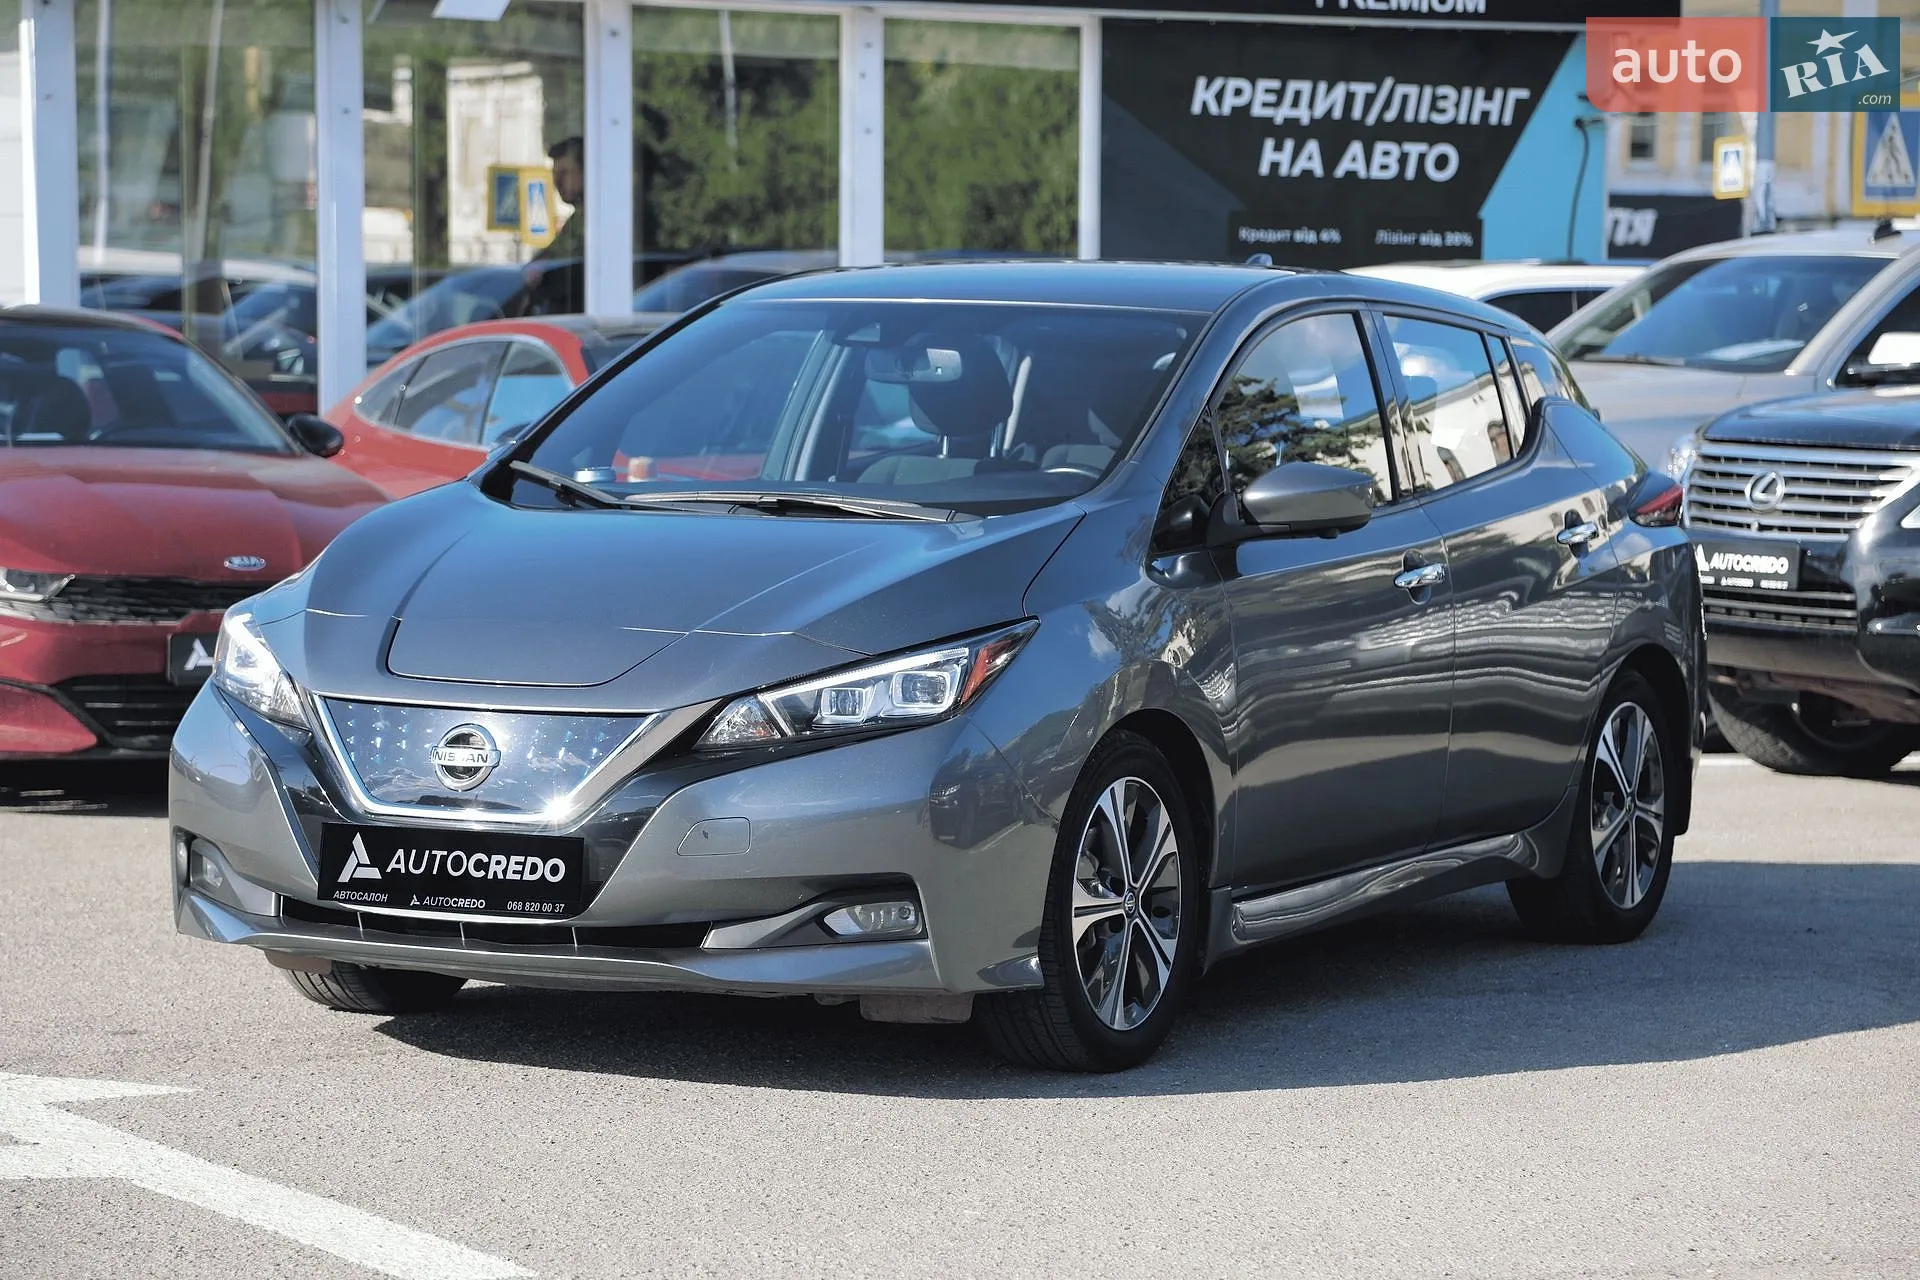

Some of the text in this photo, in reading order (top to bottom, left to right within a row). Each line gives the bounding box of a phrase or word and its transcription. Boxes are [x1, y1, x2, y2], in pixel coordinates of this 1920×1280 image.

[1190, 76, 1530, 127] КРЕДИТ/ЛІЗІНГ
[1258, 137, 1460, 183] НА АВТО
[433, 749, 489, 763] NISAN
[385, 848, 566, 883] AUTOCREDO
[333, 890, 389, 903] АВТОСАЛОН
[422, 895, 486, 909] AUTOCREDO
[507, 901, 565, 913] 068 820 00 37
